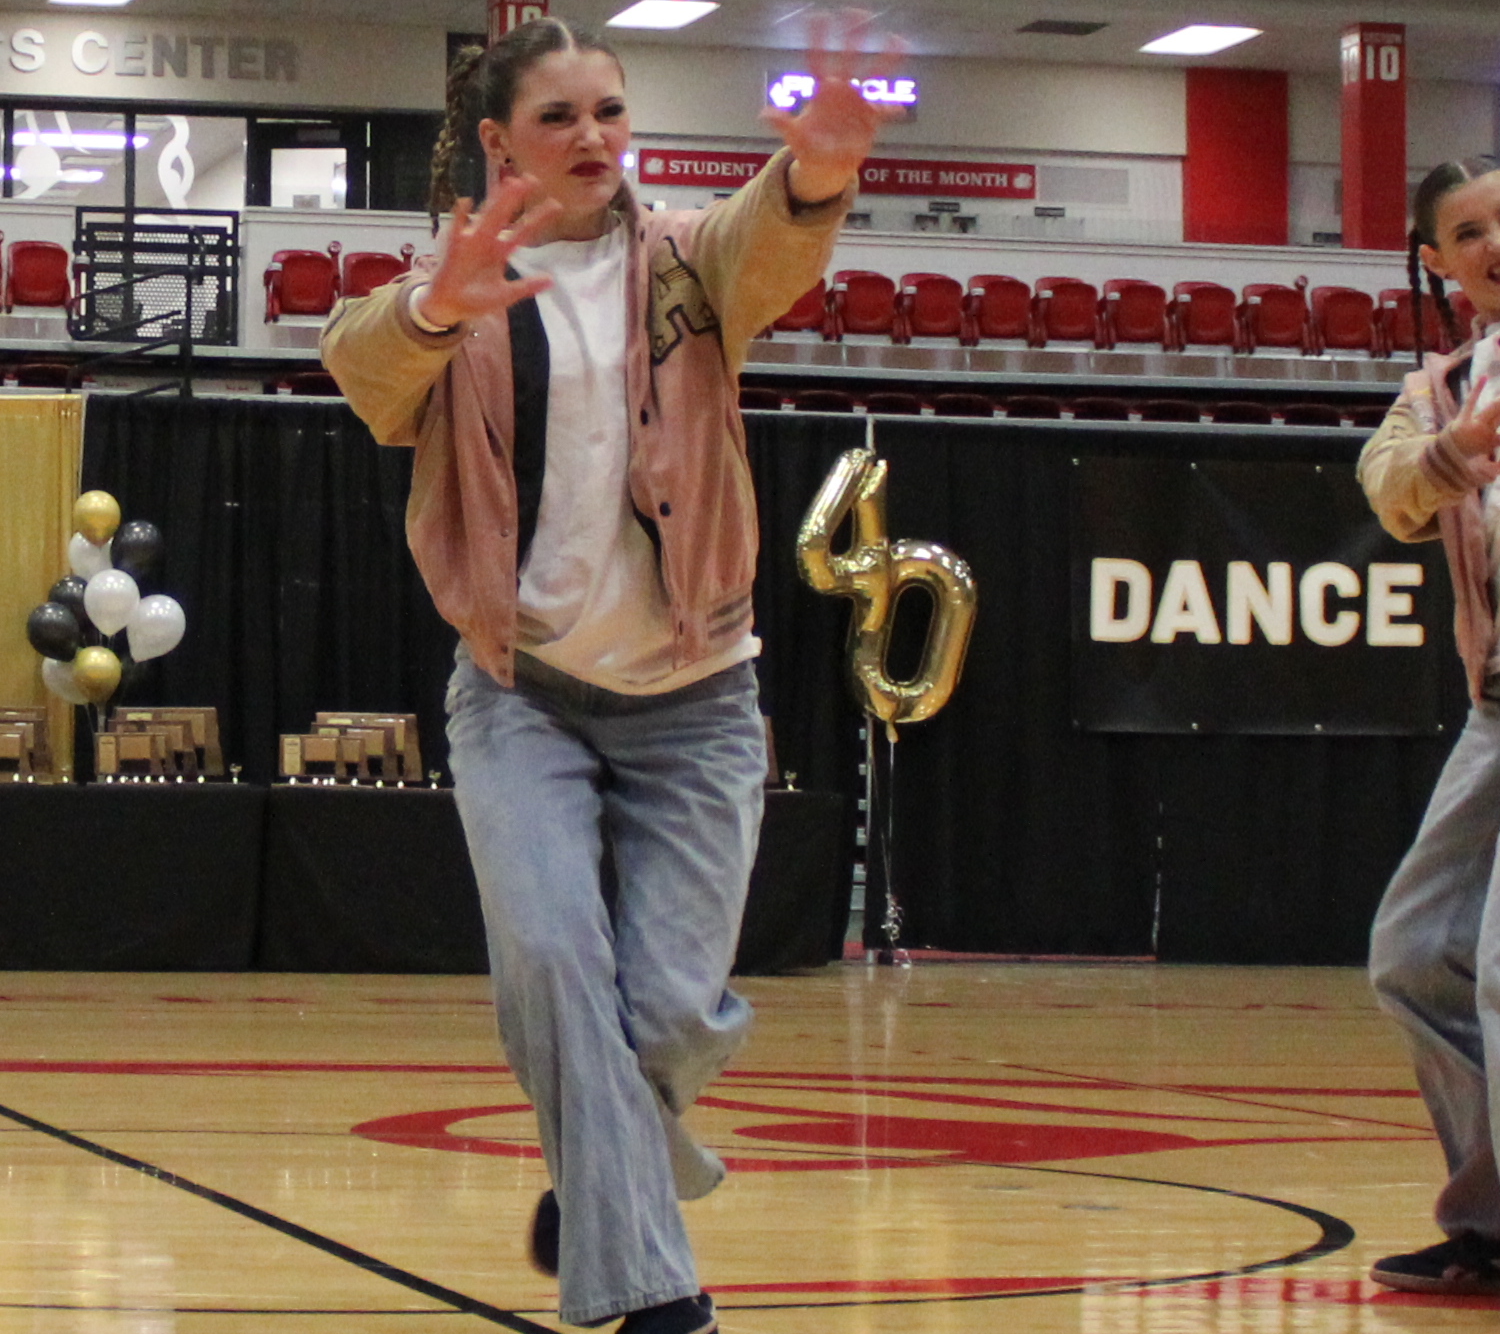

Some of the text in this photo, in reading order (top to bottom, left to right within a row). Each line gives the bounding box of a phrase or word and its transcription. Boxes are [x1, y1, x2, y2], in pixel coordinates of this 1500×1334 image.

[70, 30, 299, 83] CENTER
[1366, 45, 1400, 81] 10
[668, 159, 758, 178] STUDENT
[864, 168, 1008, 189] OF THE MONTH
[1089, 556, 1425, 647] DANCE
